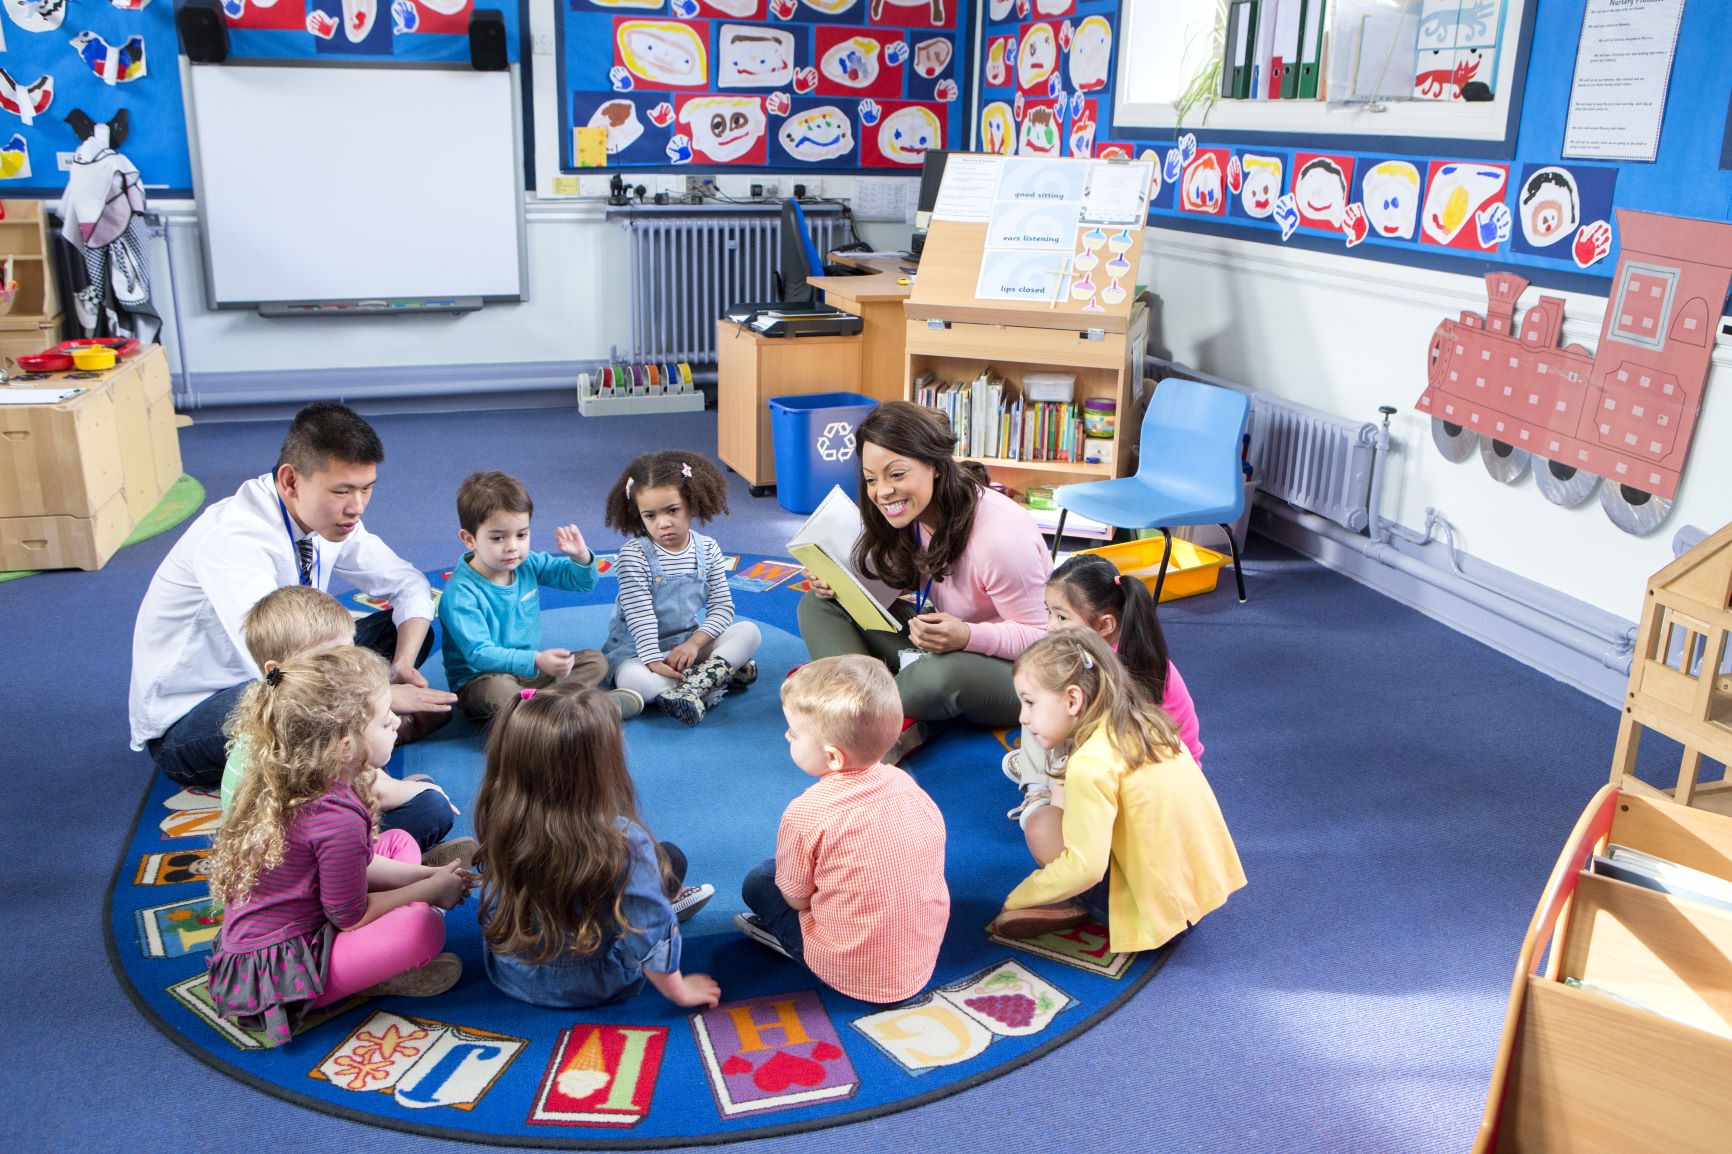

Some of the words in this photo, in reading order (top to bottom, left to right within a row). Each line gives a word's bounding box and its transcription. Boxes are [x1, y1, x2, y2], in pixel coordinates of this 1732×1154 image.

[1014, 191, 1035, 199] good
[1037, 191, 1064, 200] sitting
[1023, 235, 1060, 243] listening
[1000, 285, 1016, 293] lips
[748, 562, 798, 582] W
[721, 999, 818, 1055] H
[871, 1005, 972, 1066] G
[397, 1043, 501, 1102] J
[594, 1028, 660, 1111] I
